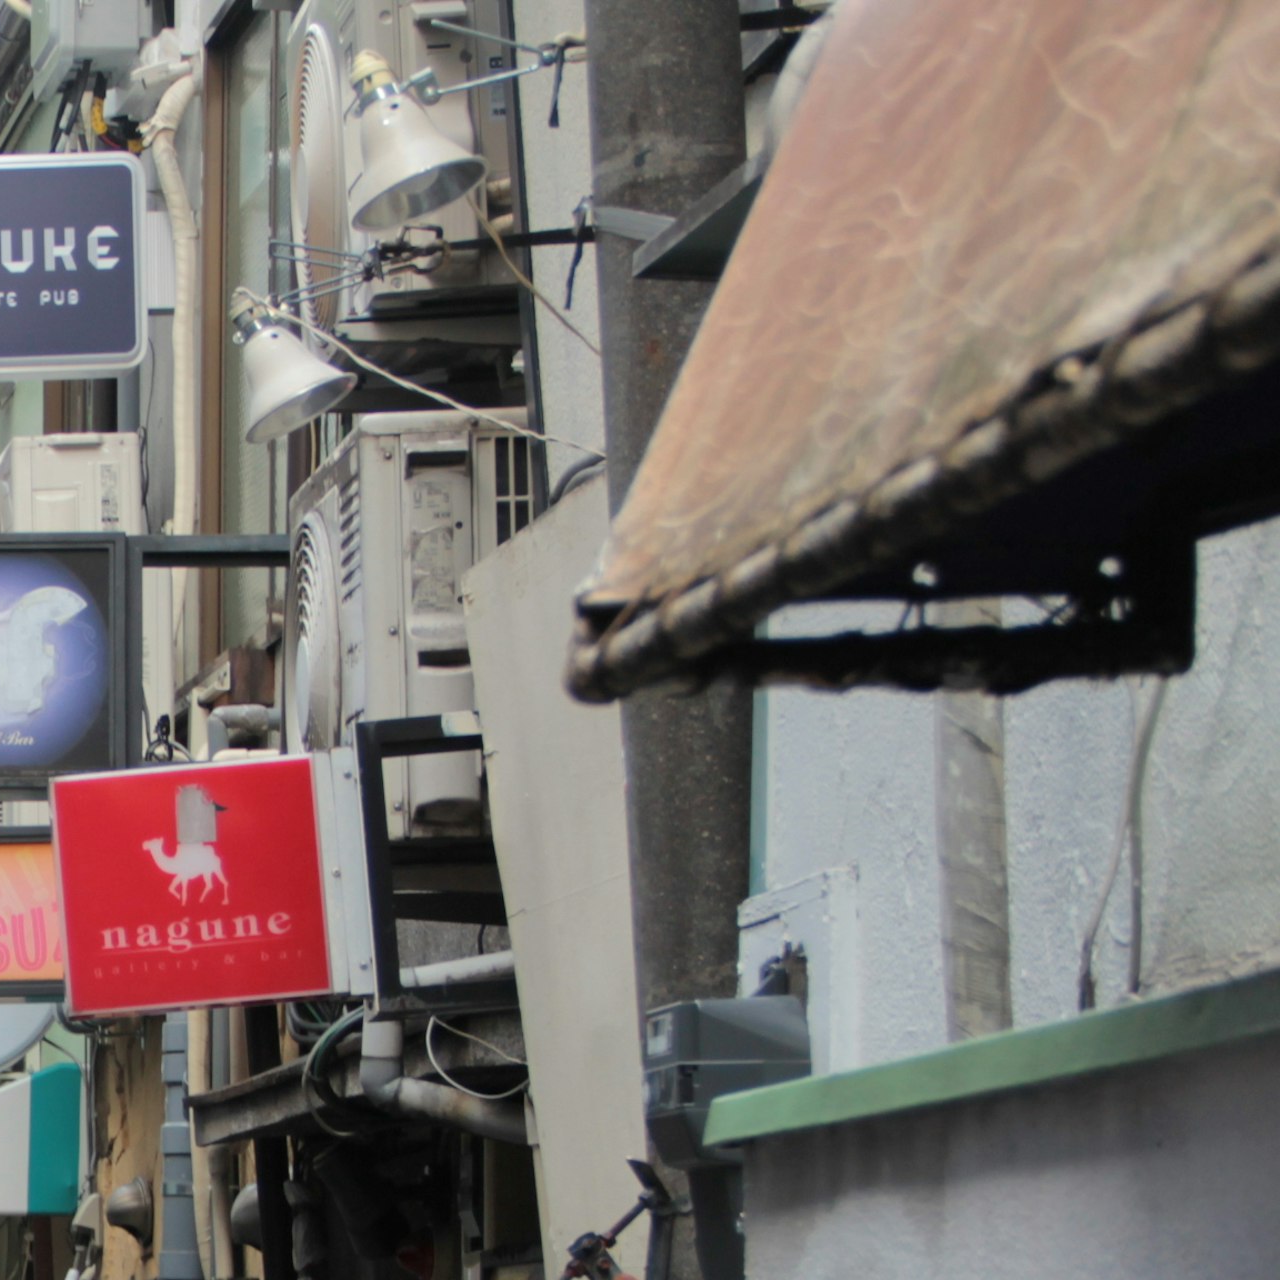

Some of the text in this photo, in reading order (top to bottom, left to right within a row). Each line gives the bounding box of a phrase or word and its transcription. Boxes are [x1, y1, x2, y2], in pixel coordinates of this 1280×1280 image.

[39, 288, 80, 306] PUB
[101, 911, 292, 953] nagune
[93, 957, 200, 979] gallery
[260, 949, 304, 962] bar
